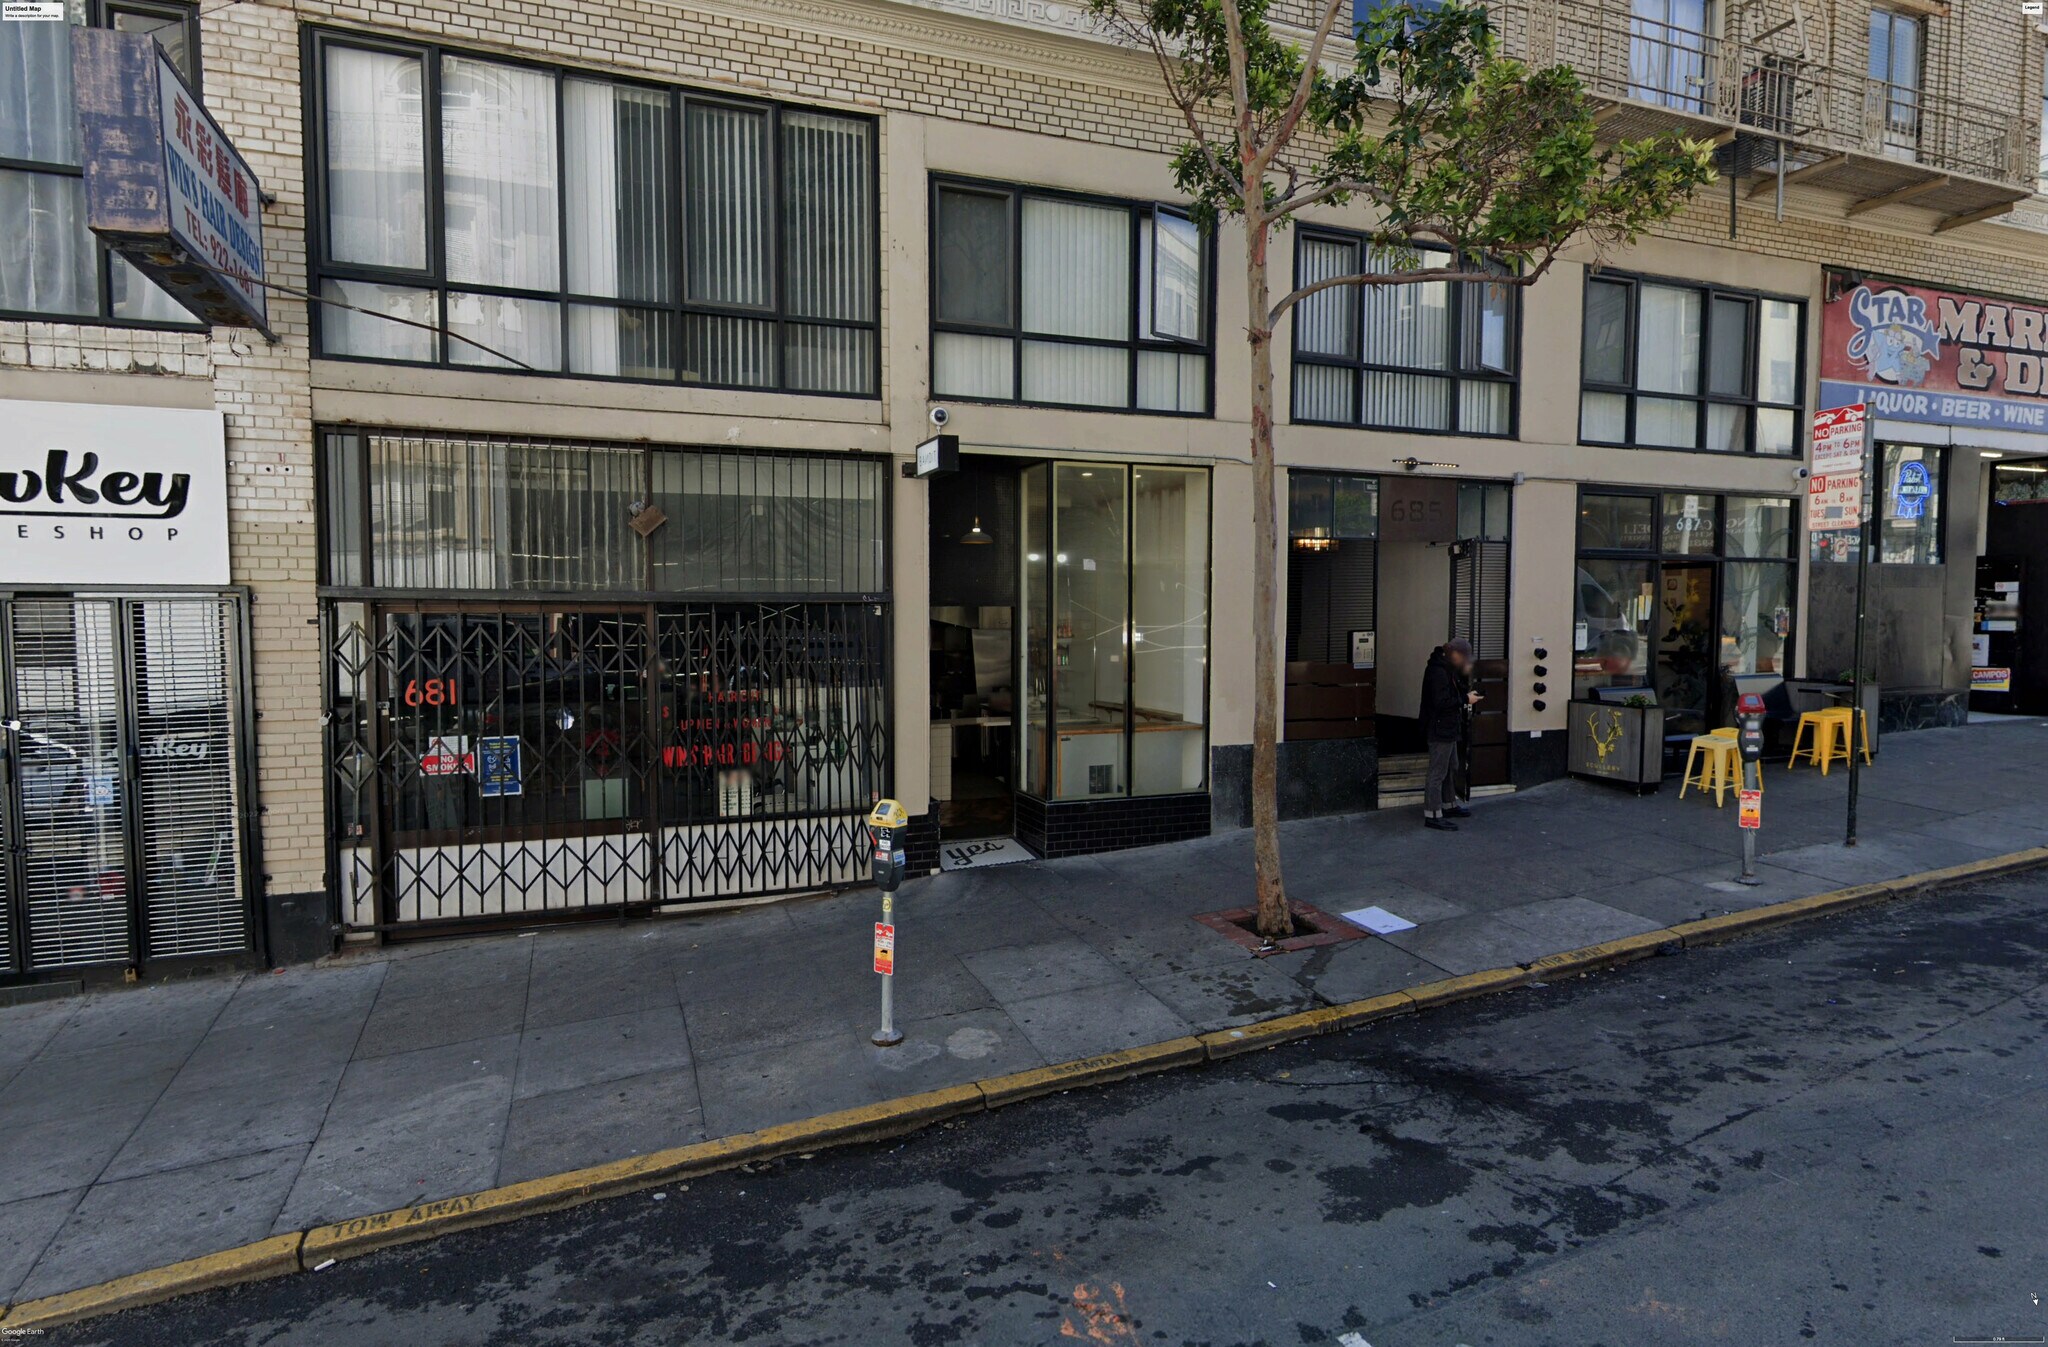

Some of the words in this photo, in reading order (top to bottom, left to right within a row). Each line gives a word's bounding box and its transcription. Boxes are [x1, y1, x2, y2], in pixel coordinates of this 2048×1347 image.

[184, 204, 208, 252] TEL:
[199, 179, 228, 242] HAIR
[228, 212, 260, 276] DESIGN
[1848, 287, 1926, 357] STAR
[1938, 298, 2048, 350] MAR
[1958, 347, 1995, 388] &
[1941, 398, 1991, 420] BEER
[2003, 404, 2045, 426] WINE
[1814, 428, 1829, 439] NO
[1830, 423, 1862, 436] PARKING
[1810, 477, 1825, 493] NO
[1827, 477, 1859, 490] PARKING
[1391, 499, 1443, 522] 685
[1676, 517, 1700, 531] 687
[1810, 509, 1825, 518] TUES
[1844, 506, 1858, 516] SUN
[404, 679, 457, 707] 681
[426, 763, 470, 773] SMOKIG
[333, 1213, 393, 1239] TOW
[406, 1194, 480, 1223] AWAY
